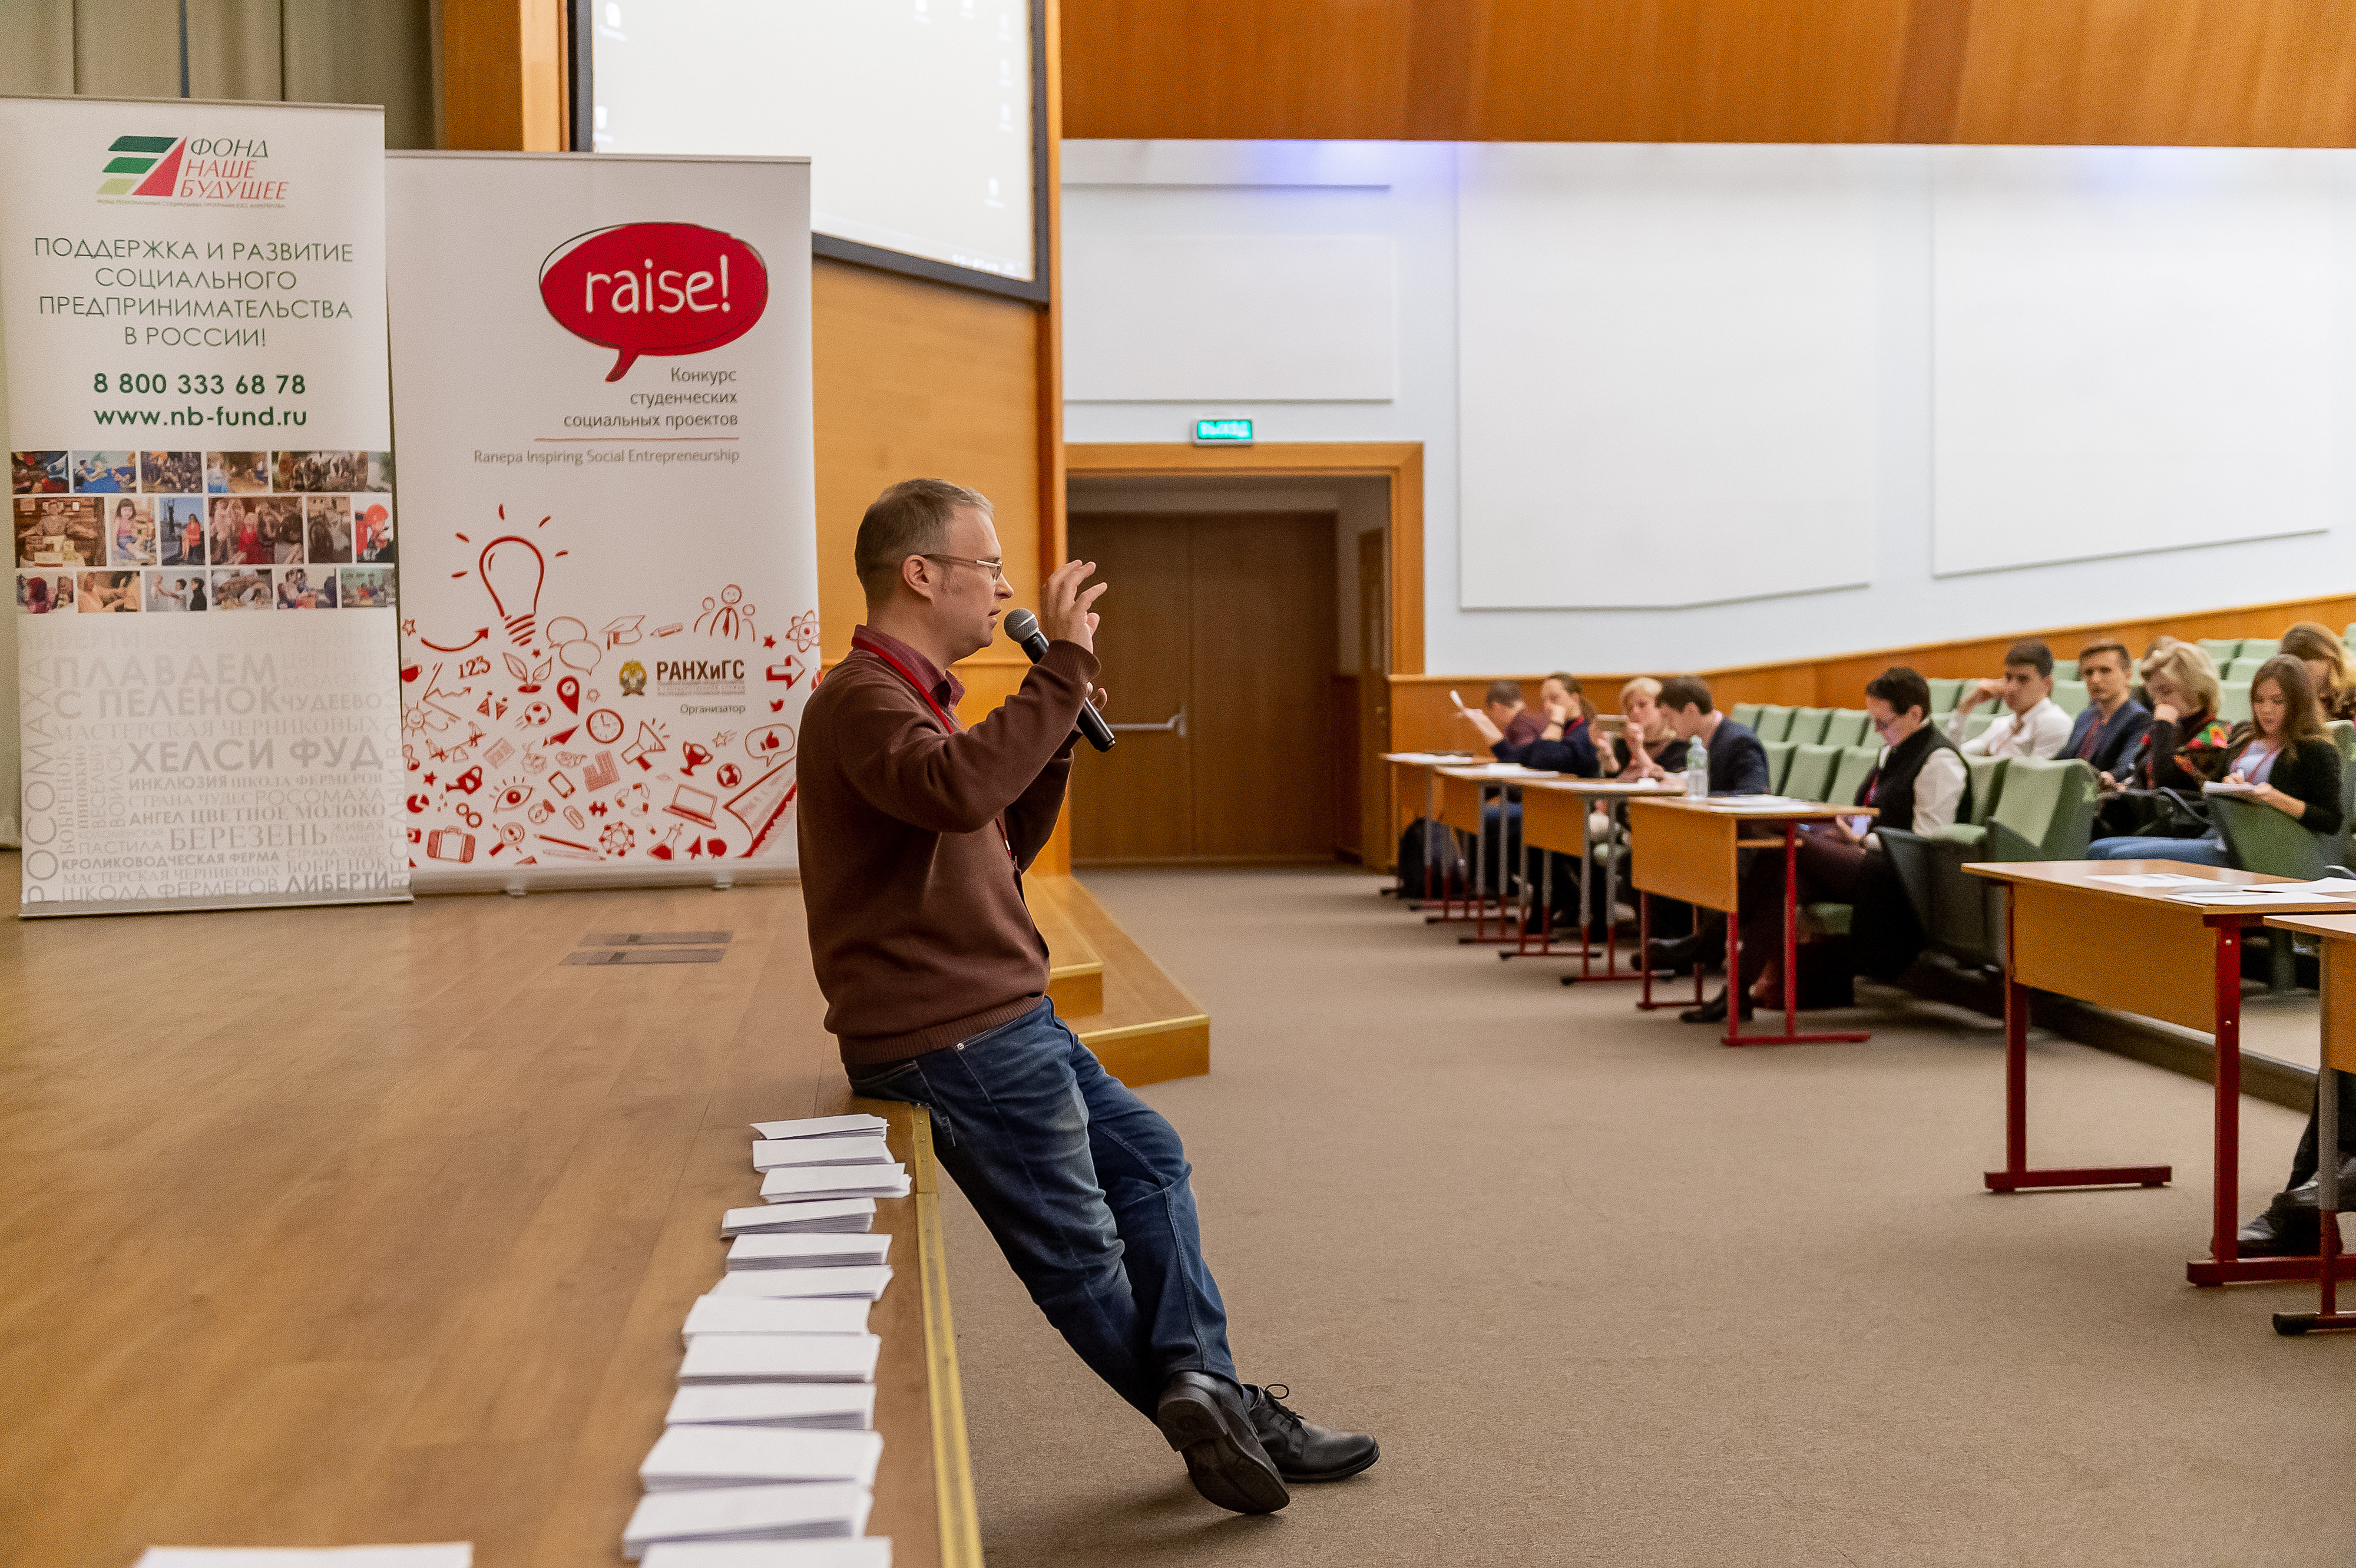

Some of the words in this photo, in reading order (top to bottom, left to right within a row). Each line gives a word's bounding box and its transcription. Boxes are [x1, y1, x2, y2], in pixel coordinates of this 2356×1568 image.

[190, 137, 269, 158] ФОНД
[184, 158, 258, 179] НАШЕ
[179, 179, 290, 200] БУДУЩЕЕ
[34, 237, 198, 259] ПОДДЕРЖКА
[208, 242, 223, 260] И
[233, 242, 353, 262] РАЗВИТИЕ
[95, 267, 297, 290] СОЦИАЛЬНОГО
[585, 254, 731, 313] raise!
[39, 296, 353, 319] ПРЕДПРИНИМАТЕЛЬСТВА
[124, 326, 137, 345] В
[147, 326, 266, 348] РОССИИ!
[94, 372, 108, 393] 8
[119, 372, 167, 394] 800
[177, 373, 225, 394] 333
[235, 373, 266, 394] 68
[276, 374, 306, 395] 78
[670, 366, 737, 386] Конкурс
[630, 391, 738, 408] студенческих
[94, 406, 307, 427] www.nb-fund.ru
[564, 413, 660, 428] социальных
[666, 413, 739, 430] проектов
[474, 449, 523, 465] Ranepa
[527, 449, 583, 465] Inspiring
[587, 449, 625, 463] Social
[628, 449, 740, 465] Entrepreneurship
[52, 652, 277, 688] ПЛАВАЕМ
[458, 656, 491, 679] 123
[656, 659, 745, 681] РАНХиГС
[54, 689, 82, 719] С
[98, 684, 281, 718] ПЕЛЕНОК
[680, 703, 746, 715] Организатор
[128, 739, 274, 773] ХЕЛСИ
[289, 735, 383, 771] ФУД
[128, 775, 227, 791] ИНКЛЮЗИЯ
[255, 787, 386, 806] РОСОМАХА
[129, 811, 184, 826] АНГЕЛ
[78, 841, 164, 854] ПАСТИЛА
[170, 823, 327, 851] БЕРЕЗЕНЬ
[61, 853, 225, 871] КРОЛИКОВОДЧЕСКАЯ
[229, 851, 280, 864] ФЕРМА
[285, 872, 389, 894] ЛИБЕРТИ
